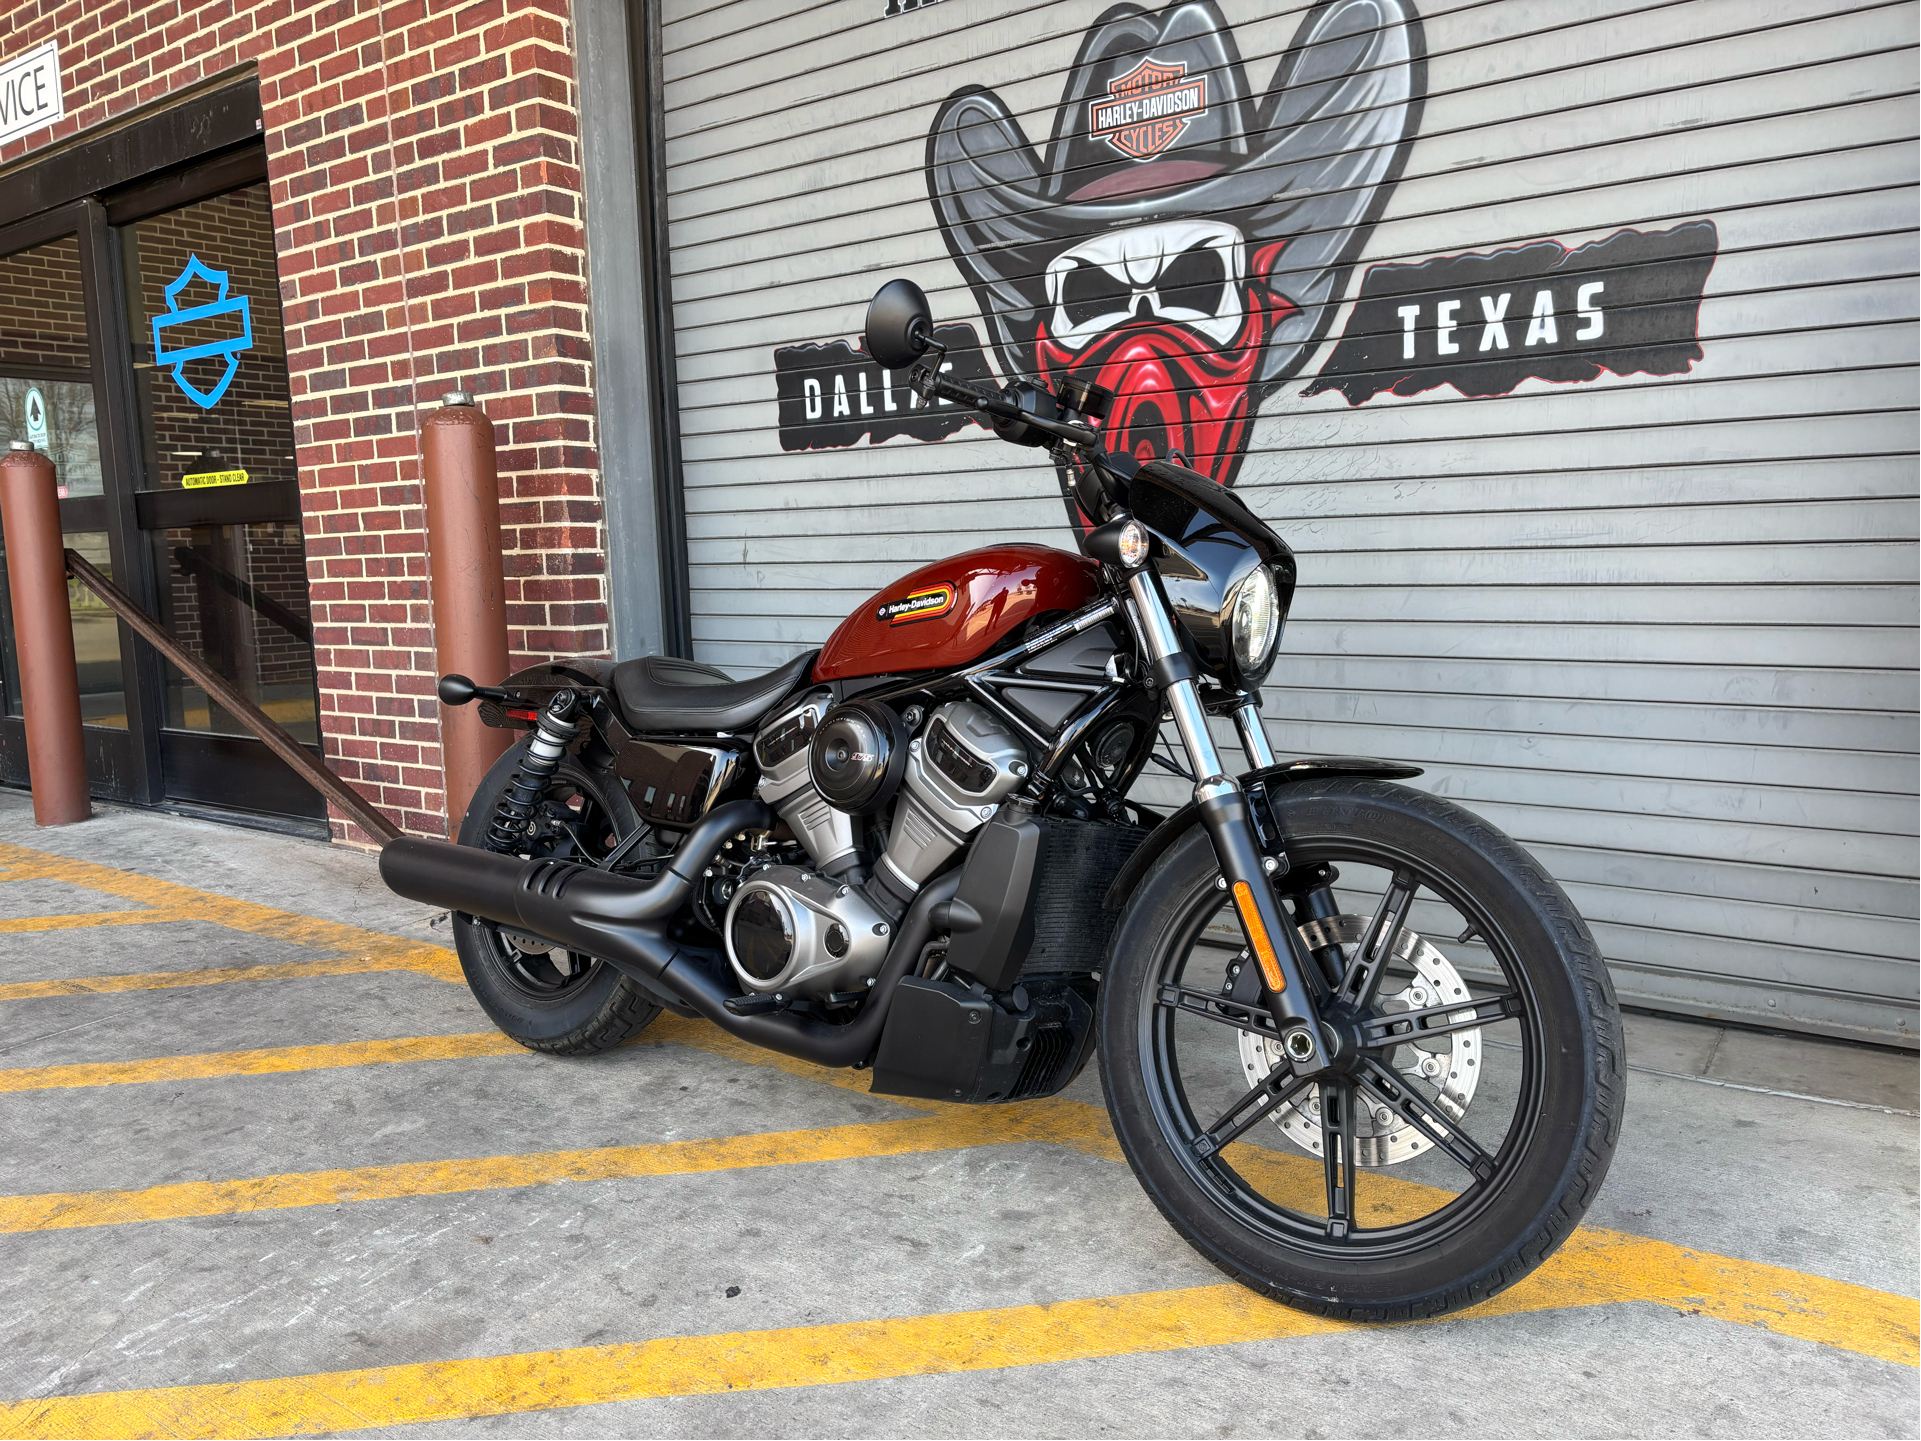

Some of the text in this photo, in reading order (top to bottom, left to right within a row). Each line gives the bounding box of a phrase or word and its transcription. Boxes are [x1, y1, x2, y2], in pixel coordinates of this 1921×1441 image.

[1121, 69, 1174, 98] MOTOR
[1098, 87, 1199, 129] HARLEY-DAVIDSON
[1120, 121, 1174, 153] CYCLES
[1397, 281, 1605, 359] TEXAS
[803, 362, 954, 420] DALL
[186, 476, 205, 486] AUTOMATIC
[206, 475, 217, 484] DOOR
[220, 474, 231, 483] STAND
[233, 473, 244, 482] CLEAR
[888, 596, 944, 614] Harley-Davidson
[1307, 806, 1396, 824] DUNLOP
